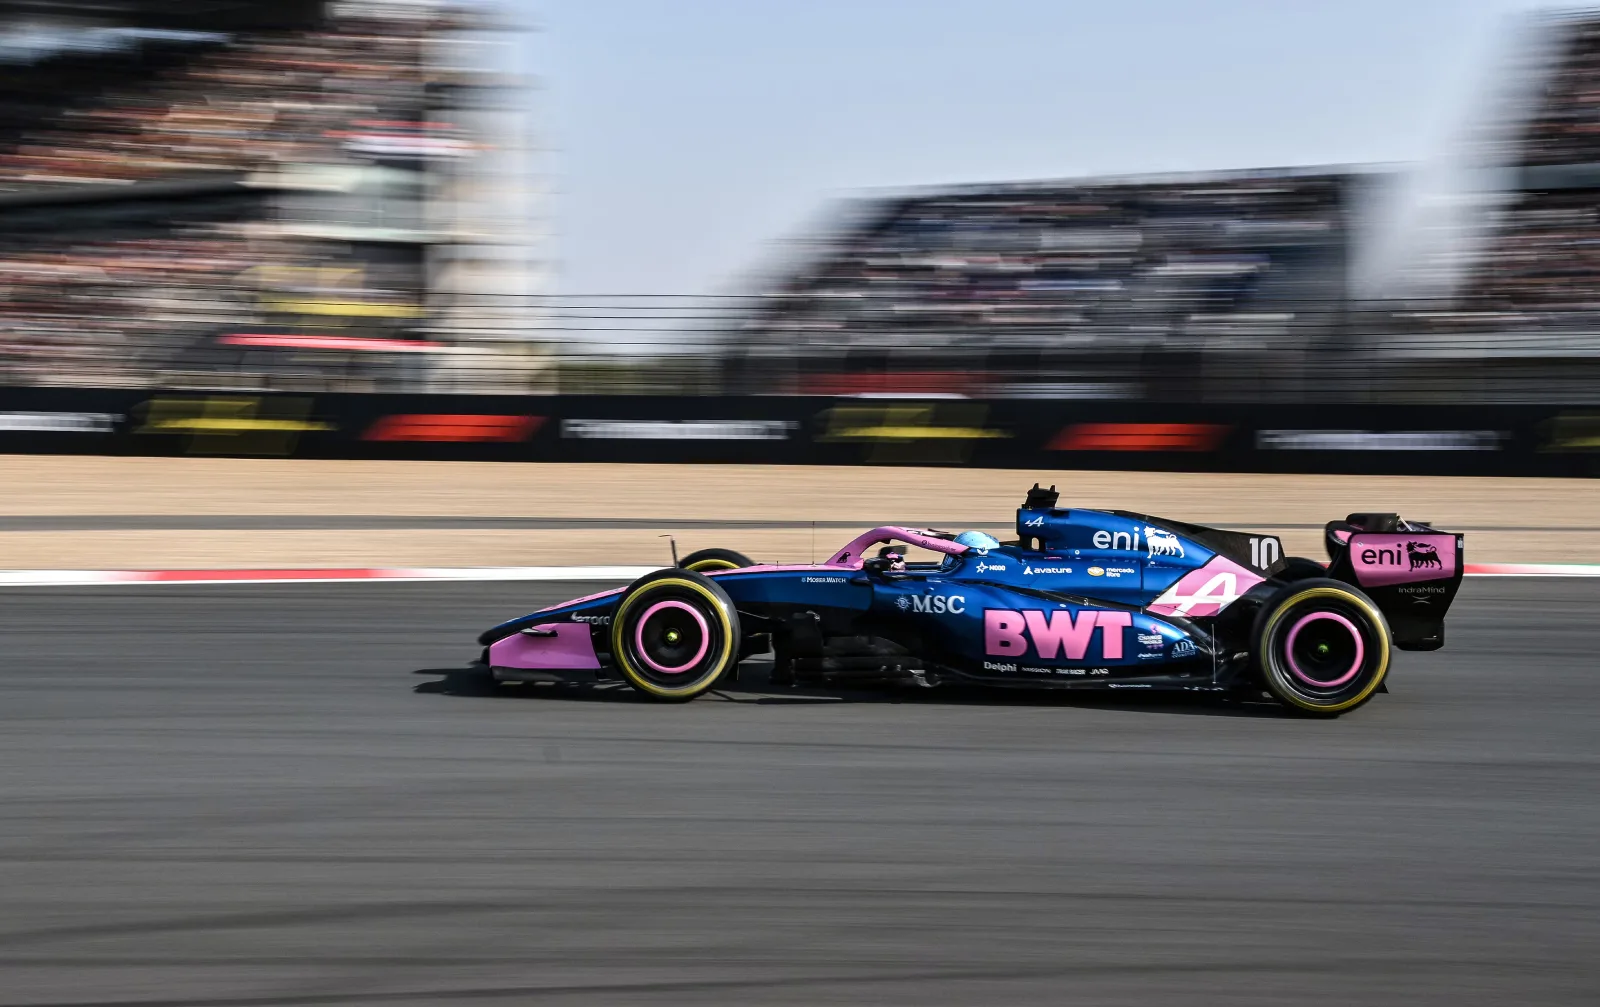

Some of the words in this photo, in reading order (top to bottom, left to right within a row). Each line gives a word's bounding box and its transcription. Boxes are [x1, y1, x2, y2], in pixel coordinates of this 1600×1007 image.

[1092, 526, 1140, 551] eni
[1249, 537, 1279, 571] 10
[1361, 543, 1402, 566] eni
[1398, 586, 1446, 594] IndraMind
[911, 594, 965, 614] MSC
[984, 609, 1132, 660] BWT
[984, 661, 1017, 672] Delphi
